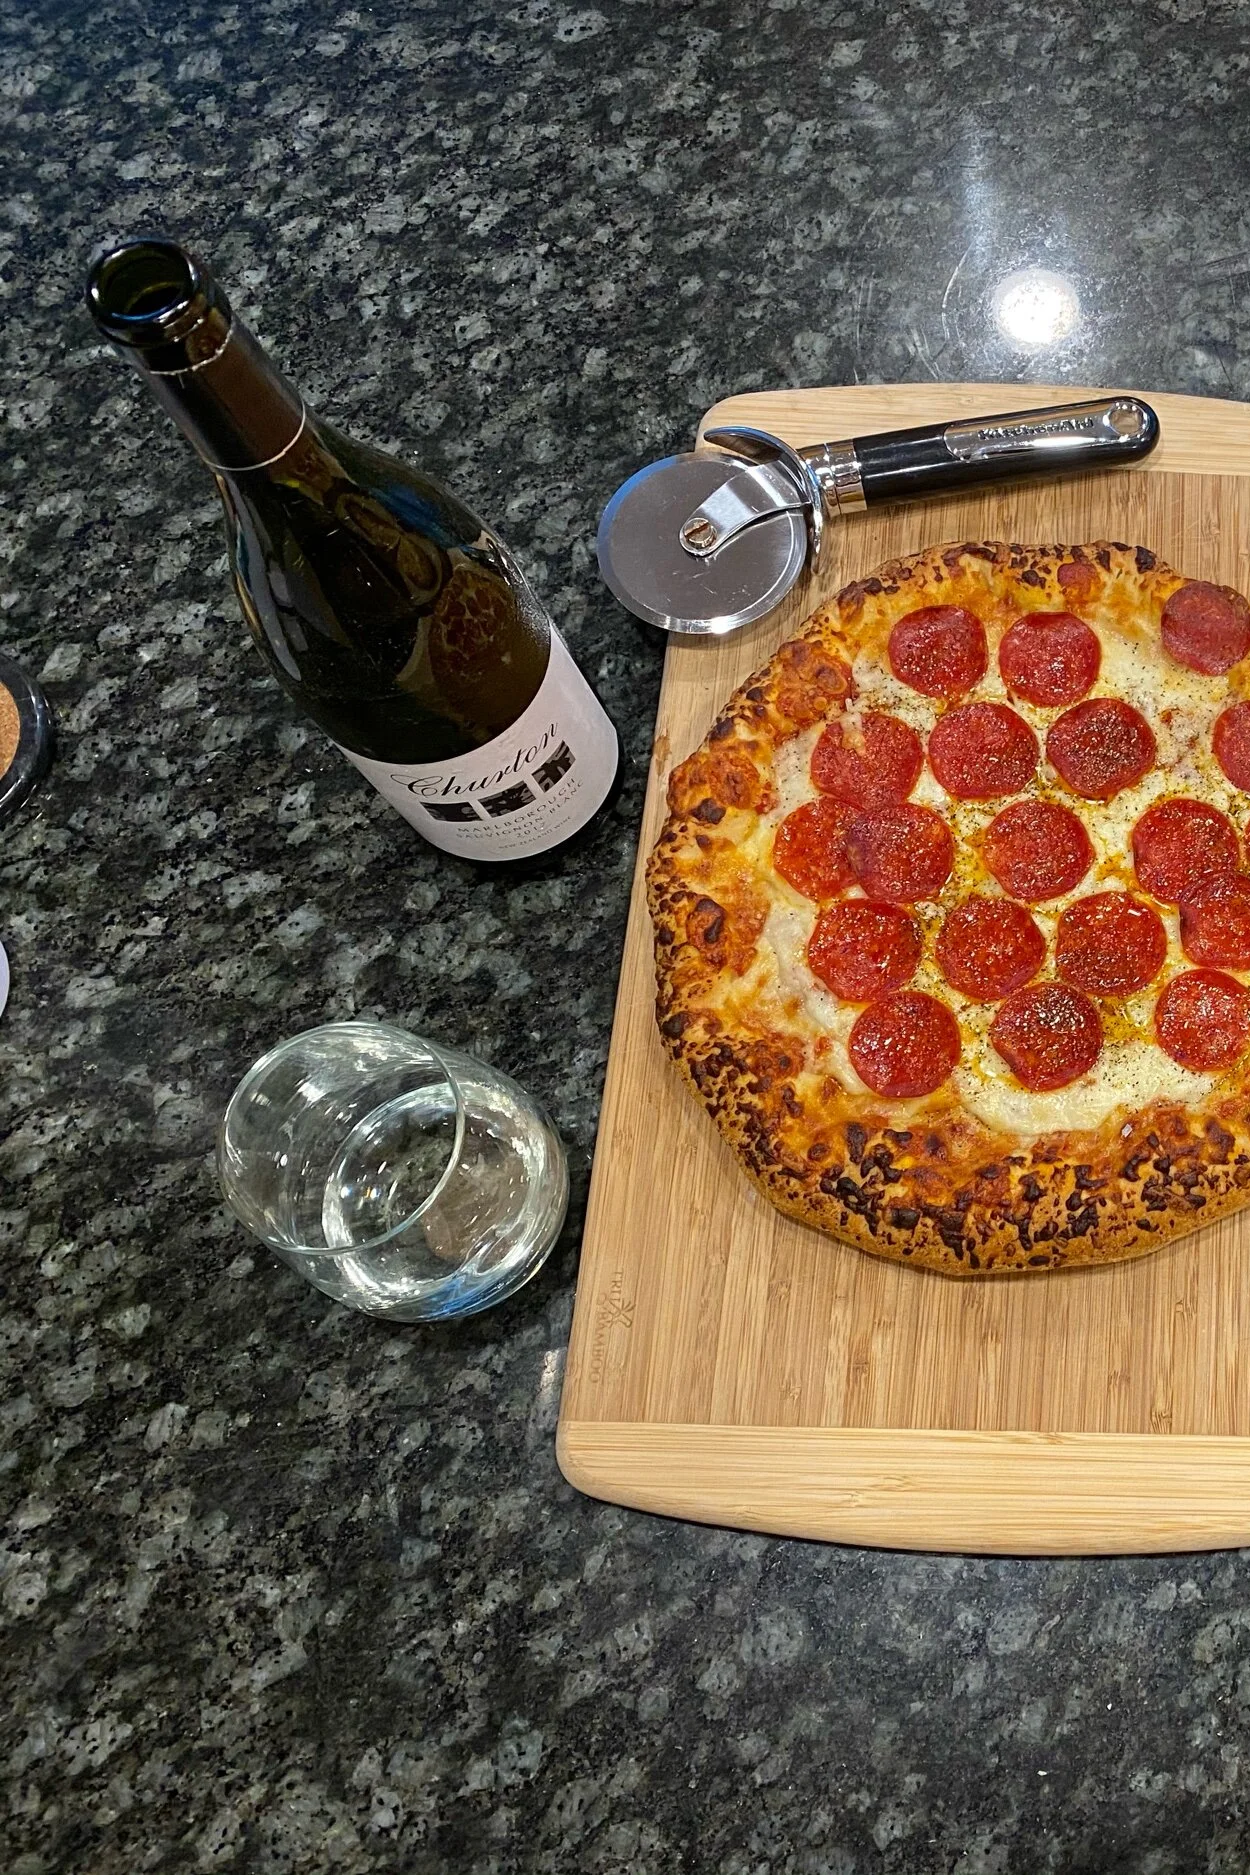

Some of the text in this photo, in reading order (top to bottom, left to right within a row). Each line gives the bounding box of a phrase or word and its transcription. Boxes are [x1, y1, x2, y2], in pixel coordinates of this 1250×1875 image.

[390, 722, 558, 797] Churton
[456, 782, 584, 839] SAUVIGNON BLANC
[458, 778, 576, 833] MARLBOROUGH
[588, 1311, 609, 1384] BAMBOO
